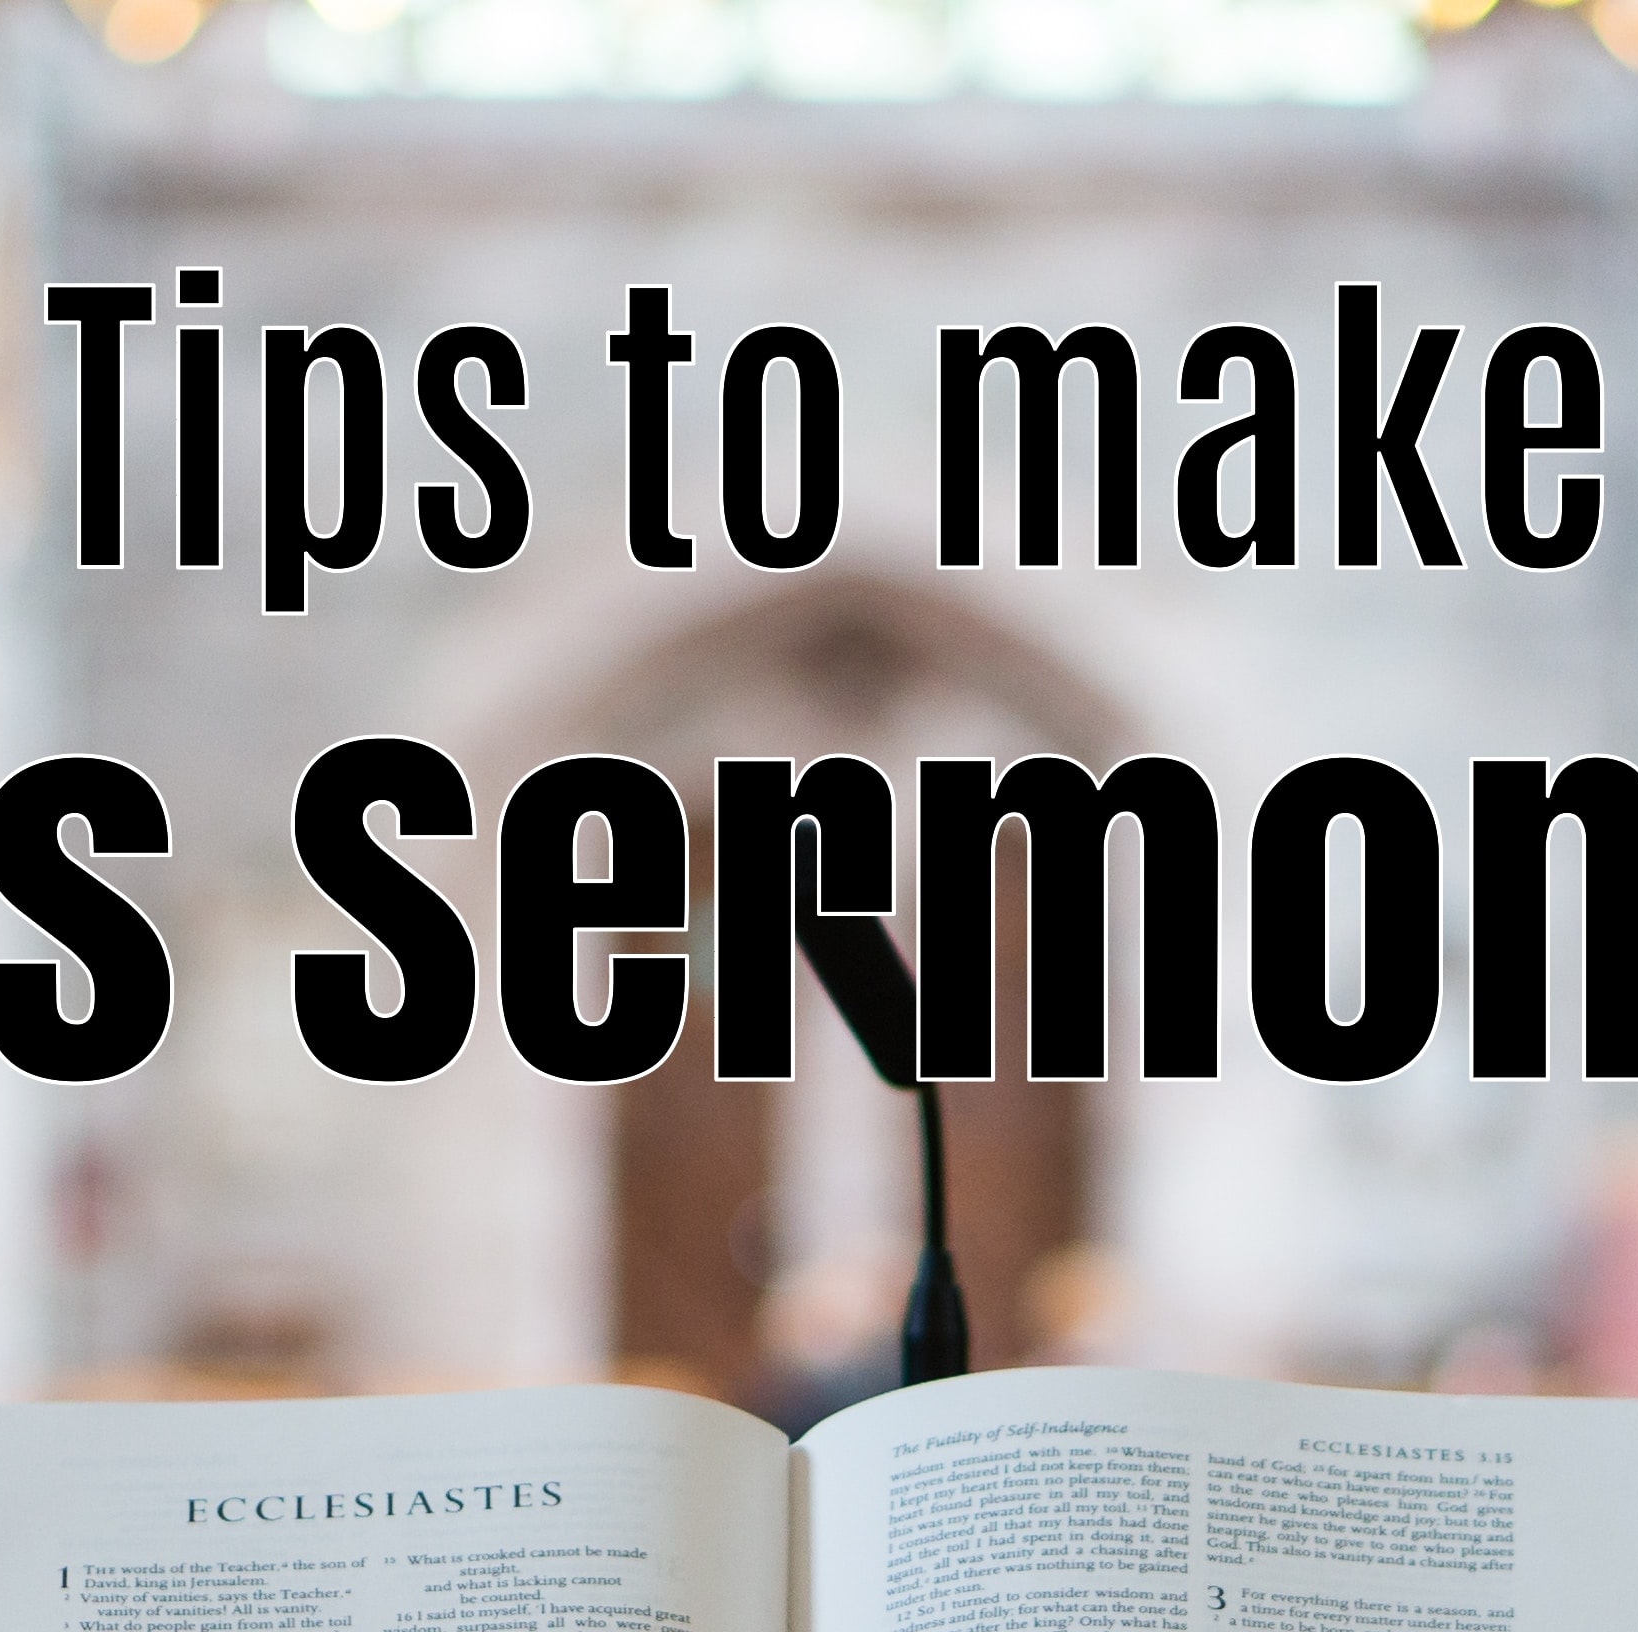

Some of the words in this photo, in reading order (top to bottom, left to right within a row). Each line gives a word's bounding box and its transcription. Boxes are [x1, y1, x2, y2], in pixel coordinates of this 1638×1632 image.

[893, 1443, 920, 1458] The
[925, 1431, 982, 1450] Futility
[986, 1425, 1003, 1442] of
[1298, 1438, 1465, 1462] ECCLESIASTES
[188, 1481, 562, 1523] ECCLESIASTES
[1207, 1482, 1223, 1493] to
[1230, 1483, 1254, 1496] the
[1261, 1489, 1289, 1500] one
[1297, 1490, 1329, 1504] who
[1336, 1494, 1390, 1509] pleases
[1397, 1498, 1429, 1512] him
[1436, 1501, 1469, 1514] God
[1476, 1506, 1514, 1518] gives
[60, 1565, 68, 1588] 1
[134, 1576, 168, 1591] king
[171, 1579, 187, 1588] in
[424, 1580, 452, 1593] and
[456, 1579, 492, 1591] what
[496, 1579, 509, 1589] is
[513, 1575, 567, 1589] lacking
[571, 1576, 622, 1586] cannot
[459, 1593, 477, 1605] be
[1207, 1585, 1226, 1610] 3
